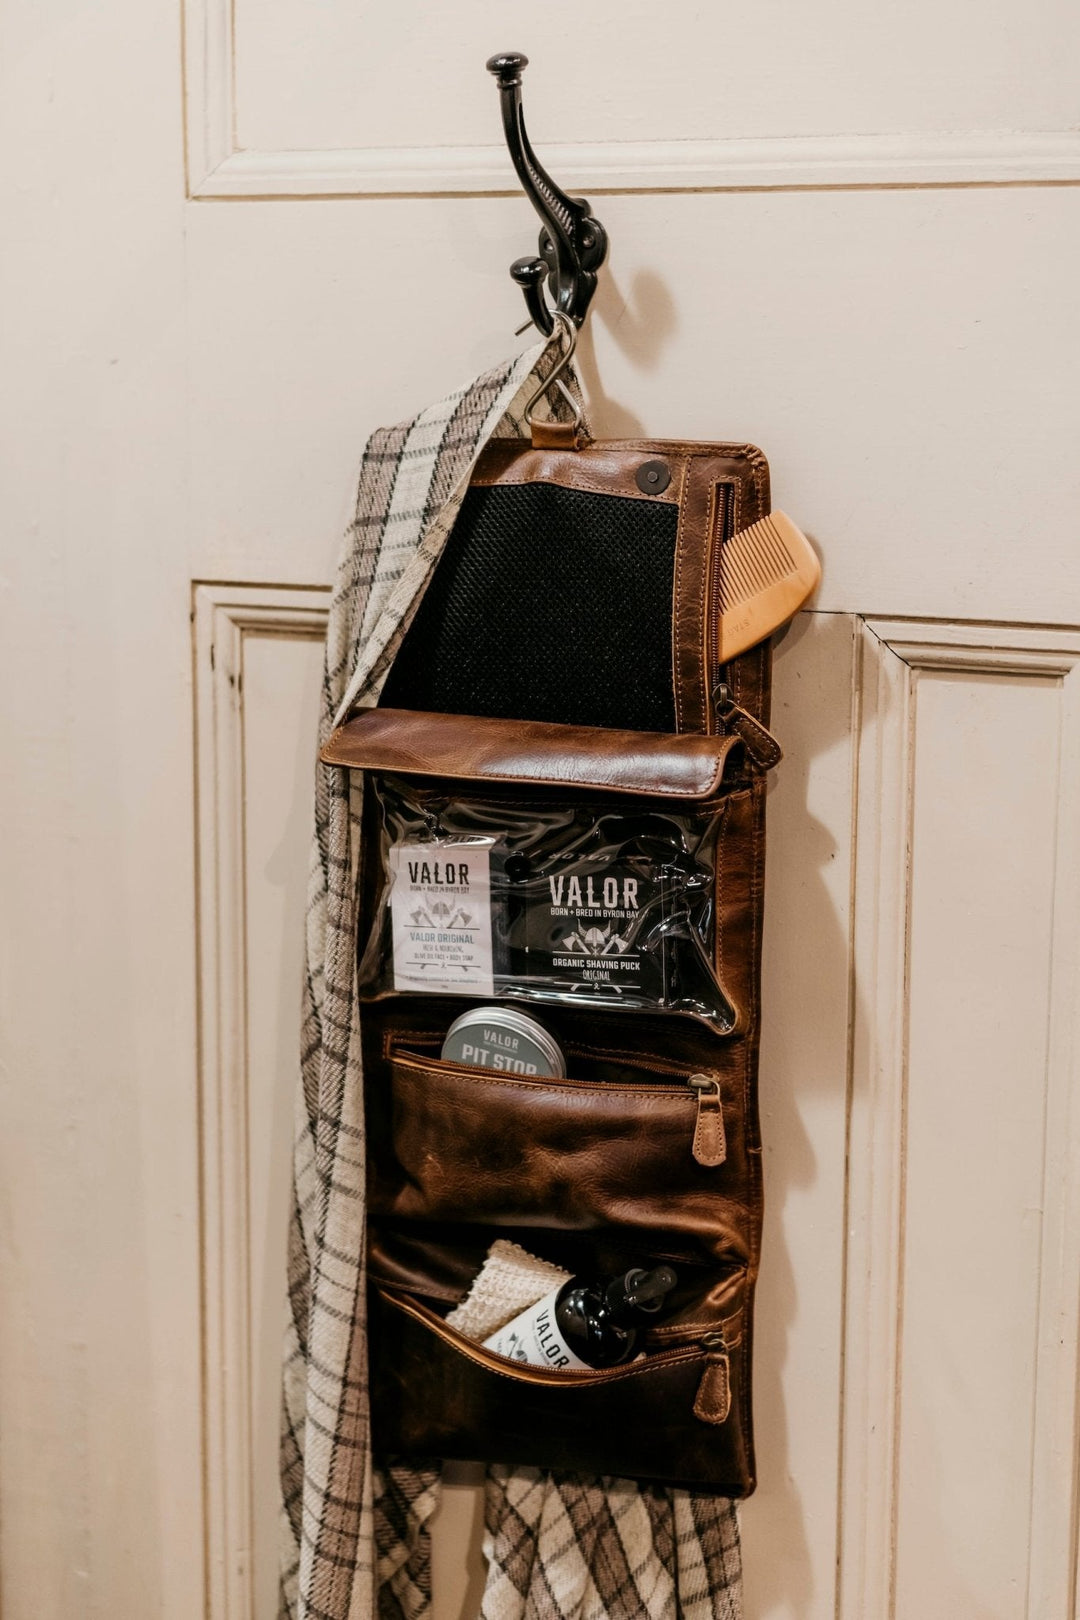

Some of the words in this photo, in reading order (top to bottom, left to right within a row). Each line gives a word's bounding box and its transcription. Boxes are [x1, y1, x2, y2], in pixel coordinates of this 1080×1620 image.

[408, 862, 469, 885] VALOR
[549, 875, 639, 909] VALOR
[550, 908, 568, 916] BORN
[575, 908, 593, 917] BRED
[594, 909, 601, 917] IN
[603, 909, 625, 918] BYRON
[626, 910, 640, 919] BAY
[410, 932, 435, 942] VALOR
[437, 933, 474, 944] ORIGINAL
[552, 958, 585, 967] ORGANIC
[586, 959, 619, 970] SHAVING
[620, 961, 640, 970] PUCK
[582, 969, 610, 980] ORIGINAL
[483, 1029, 519, 1049] VALOR
[461, 1043, 490, 1066] PIT
[493, 1053, 537, 1075] STOP
[536, 1309, 570, 1368] VALOR
